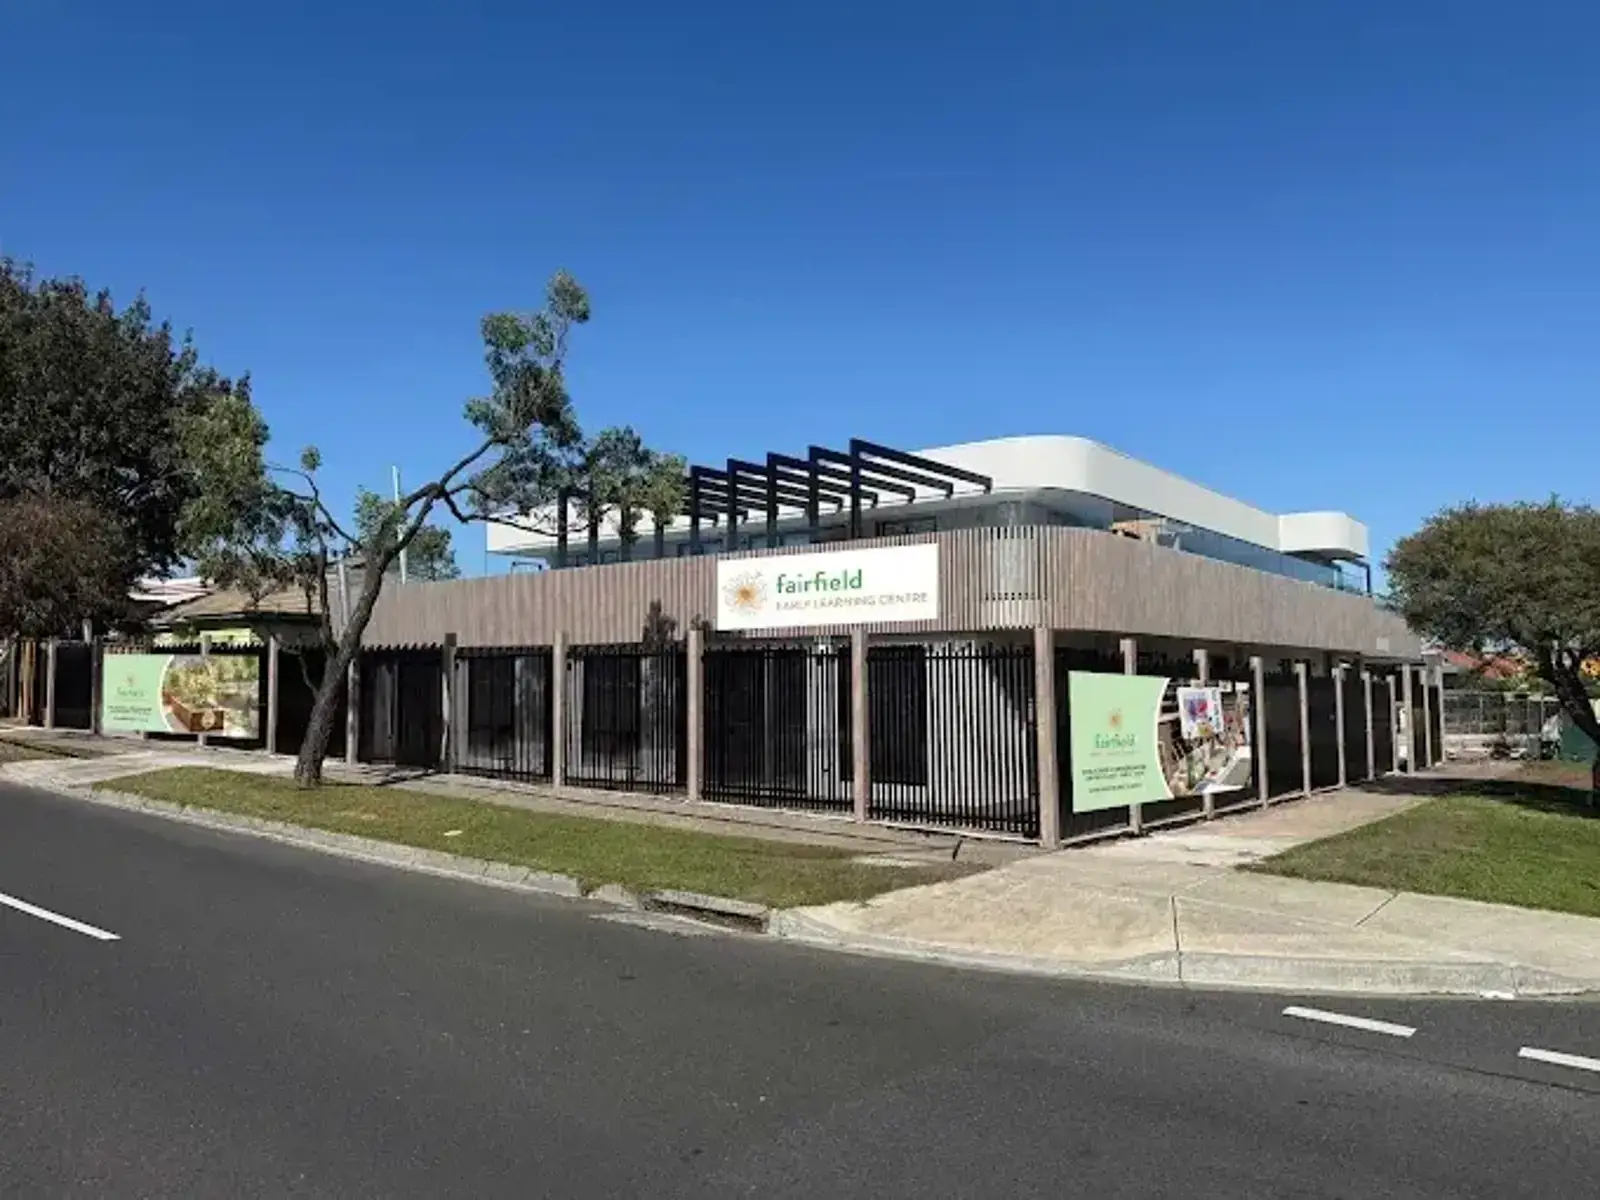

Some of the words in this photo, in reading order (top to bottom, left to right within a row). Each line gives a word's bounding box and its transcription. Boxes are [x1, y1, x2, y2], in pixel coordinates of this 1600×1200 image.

[776, 568, 863, 594] fairfield
[813, 595, 876, 609] LEARNING
[879, 592, 928, 606] CENTRE
